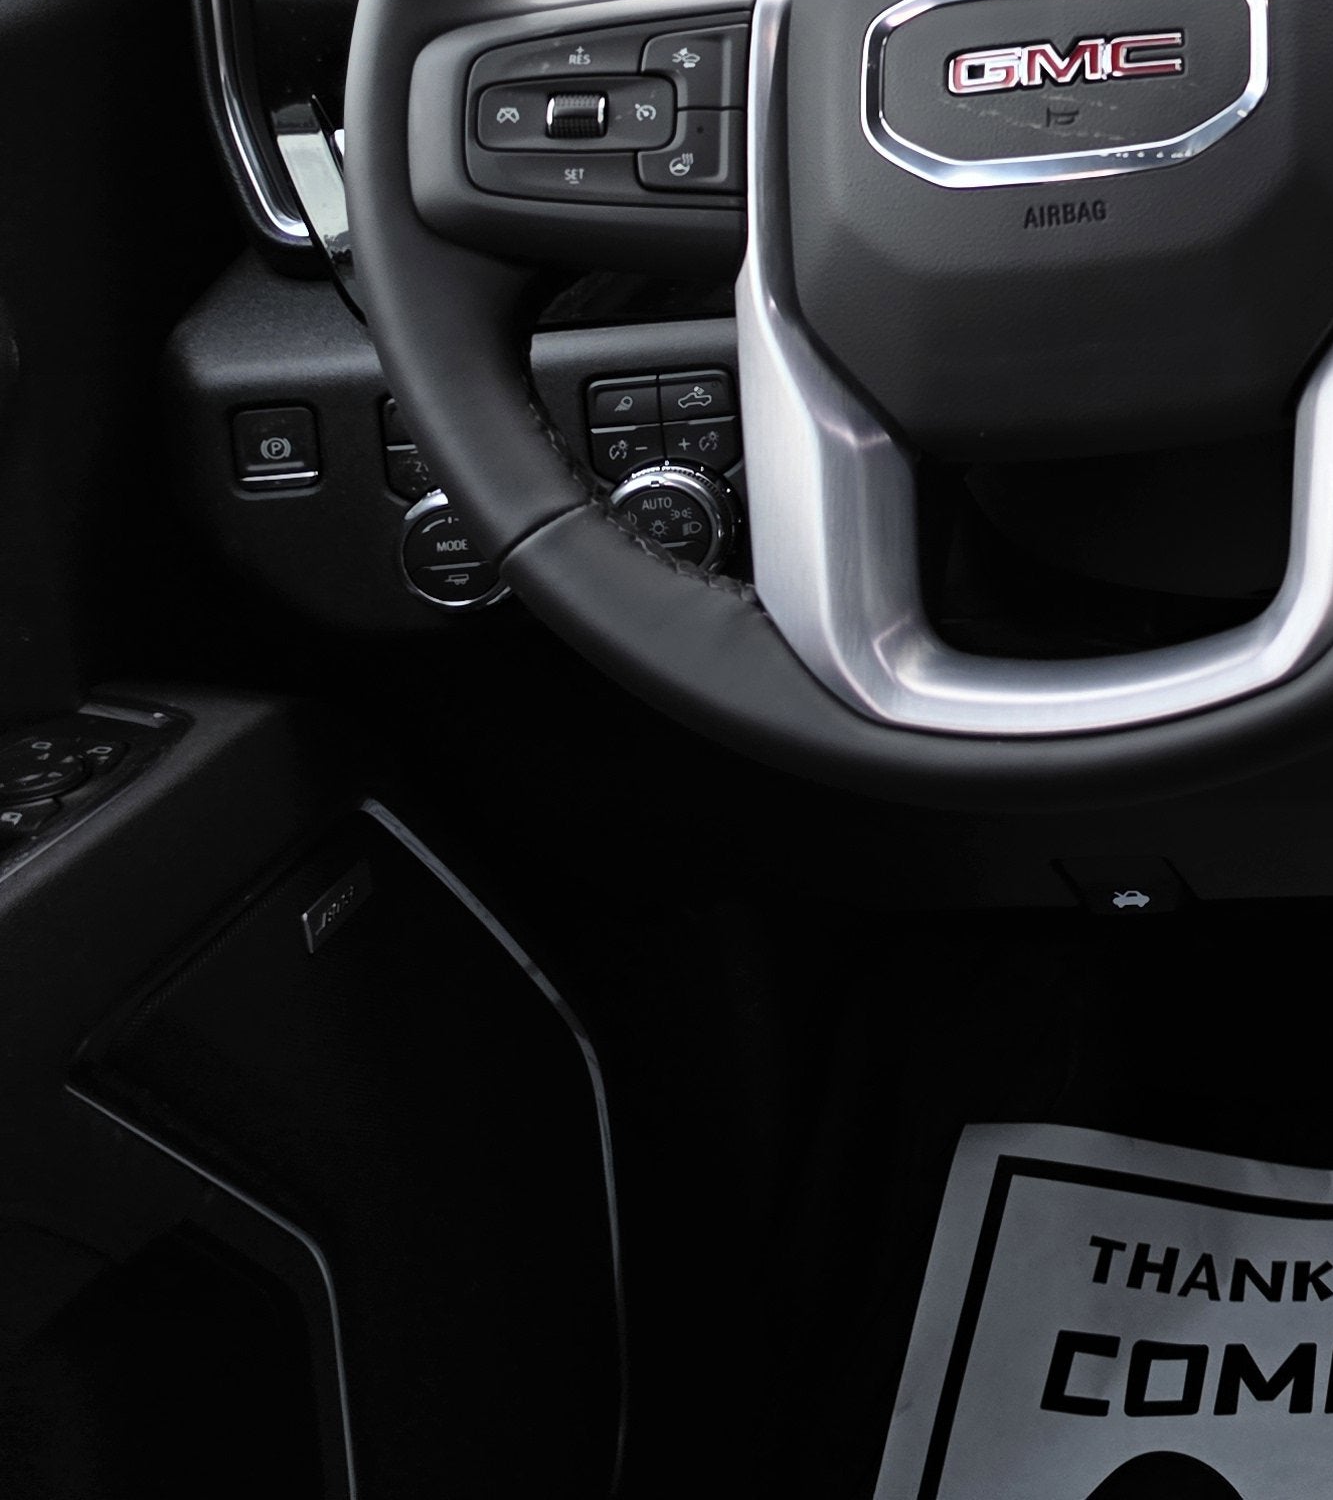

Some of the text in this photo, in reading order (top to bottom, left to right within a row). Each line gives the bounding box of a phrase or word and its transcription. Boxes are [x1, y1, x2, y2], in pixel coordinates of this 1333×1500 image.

[568, 53, 591, 66] RES
[947, 31, 1183, 95] GMC
[564, 167, 585, 181] SET
[1023, 200, 1107, 229] AIRBAG
[641, 496, 673, 510] AUTO
[436, 538, 470, 553] MODE
